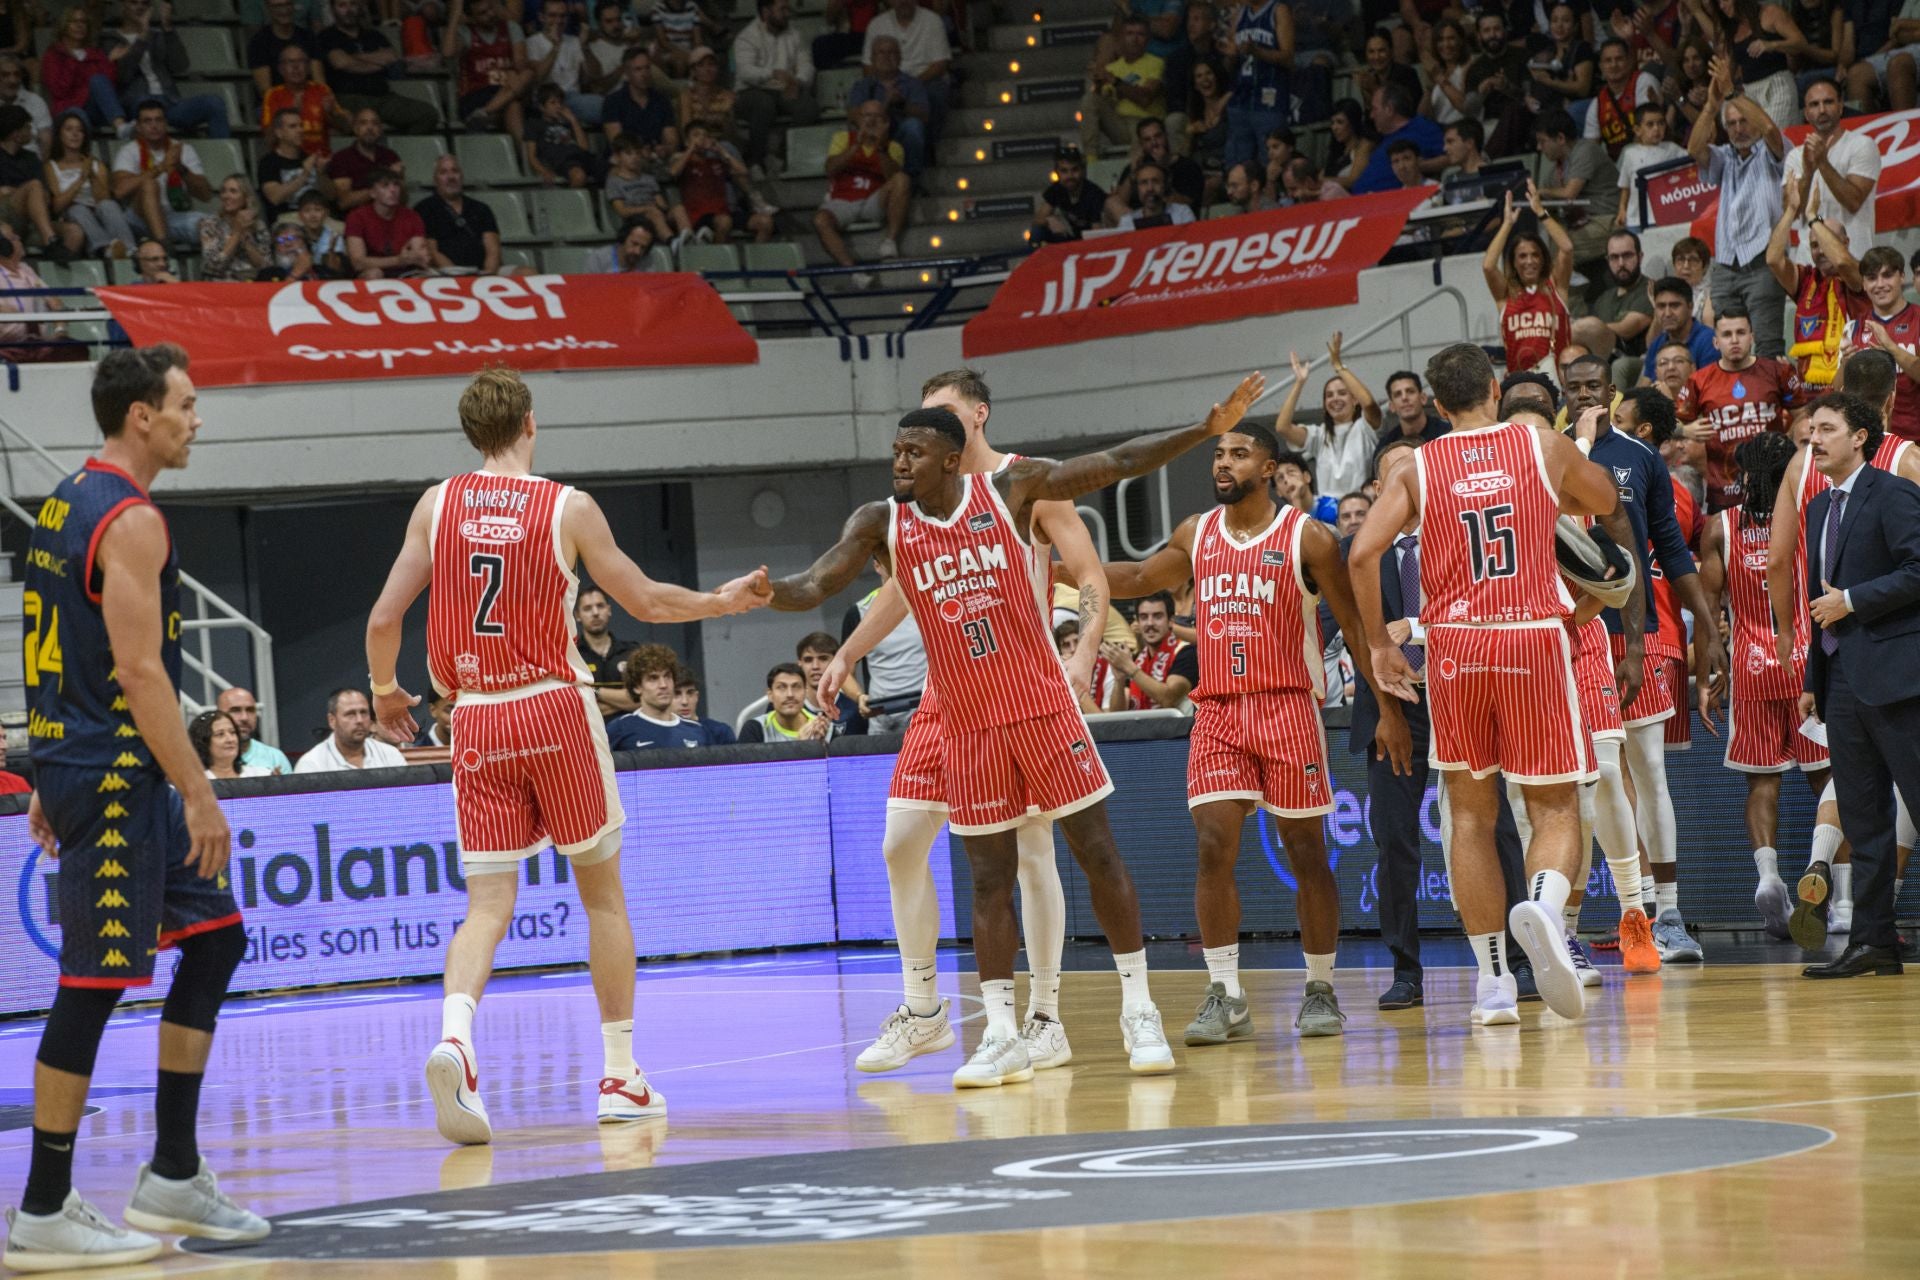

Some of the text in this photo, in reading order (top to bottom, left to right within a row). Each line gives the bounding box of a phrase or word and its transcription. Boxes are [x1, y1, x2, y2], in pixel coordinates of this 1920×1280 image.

[1130, 216, 1361, 288] Renesur
[317, 274, 567, 326] caser
[1508, 311, 1559, 332] UCAM
[1709, 401, 1777, 430] UCAM
[1459, 503, 1517, 584] 15
[911, 543, 1009, 592] UCAM
[469, 552, 505, 637] 2
[933, 574, 997, 604] MURCIA
[1200, 572, 1276, 605] UCAM
[1209, 600, 1262, 617] MURCIA
[23, 590, 64, 694] 24
[963, 616, 998, 659] 31
[1231, 641, 1247, 676] 5
[320, 926, 379, 956] son
[390, 917, 440, 950] tus
